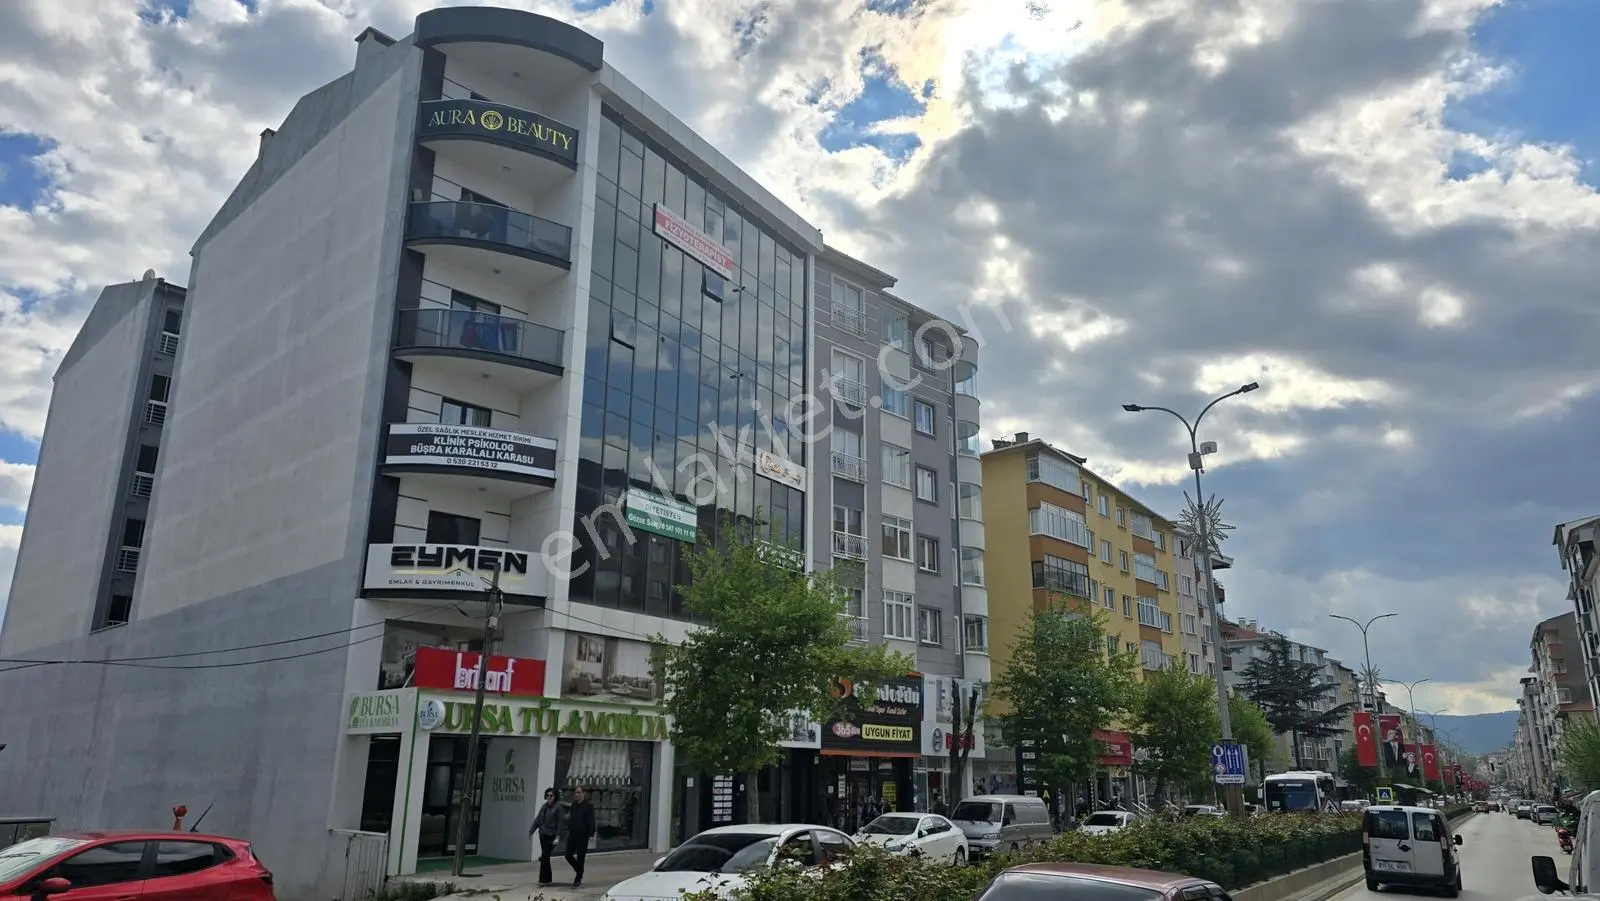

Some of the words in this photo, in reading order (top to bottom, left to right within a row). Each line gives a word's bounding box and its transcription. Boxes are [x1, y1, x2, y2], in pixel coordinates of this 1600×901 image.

[428, 110, 476, 127] AURA
[507, 117, 573, 150] BEAUTY
[416, 426, 433, 434] ÖZEL
[434, 426, 459, 435] SAĞLIK
[461, 429, 487, 437] MESLEK
[433, 435, 466, 447] KLİNİK
[467, 438, 514, 452] PSİKOLOG
[410, 443, 443, 455] BÜŞRA
[444, 446, 496, 459] KARALALI
[496, 451, 534, 464] KARASU
[390, 546, 528, 574] EYMEN
[360, 693, 400, 716] BURSA
[865, 727, 891, 738] UYGUN
[892, 727, 911, 739] FİYAT
[492, 776, 525, 793] BURSA
